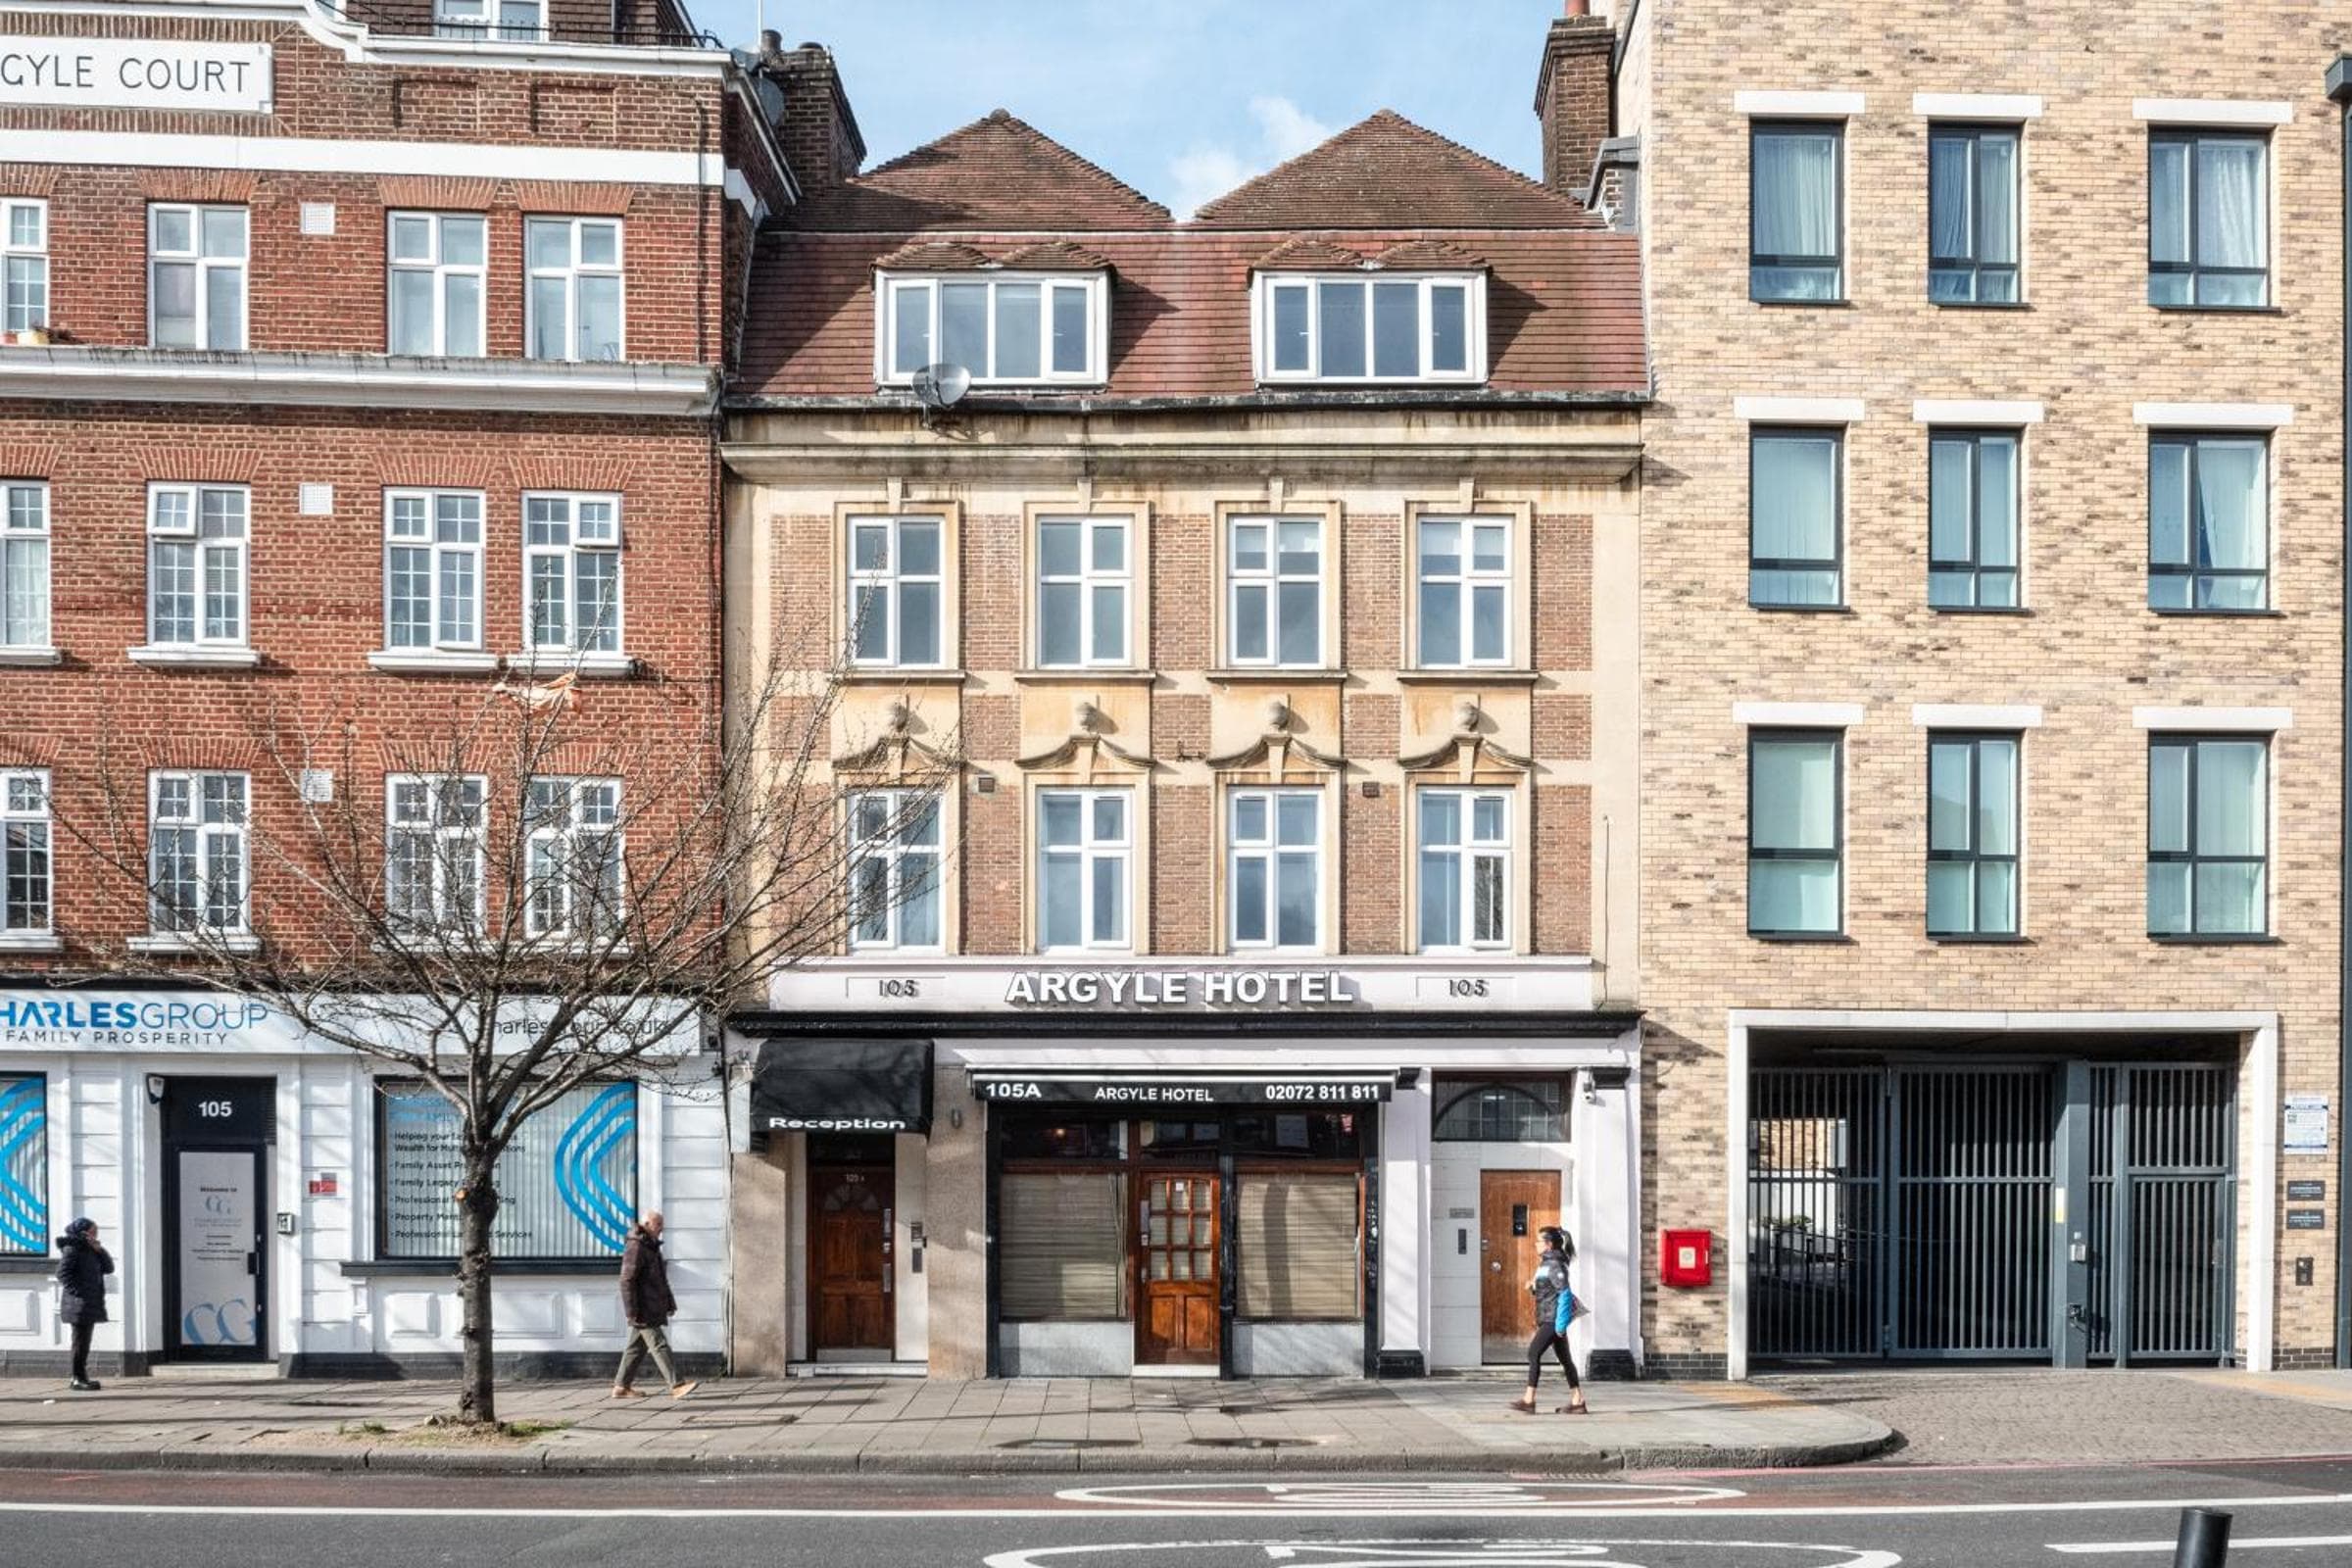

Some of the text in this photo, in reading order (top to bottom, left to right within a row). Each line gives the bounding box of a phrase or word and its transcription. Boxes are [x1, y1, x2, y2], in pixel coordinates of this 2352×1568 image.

[119, 57, 251, 93] COURT
[879, 979, 915, 997] 105
[1004, 971, 1353, 1004] ARGYLE HOTEL
[1449, 979, 1485, 997] 105
[6, 1030, 228, 1046] FAMILY PROSPERITY
[985, 1082, 1043, 1100] 105A
[1094, 1086, 1215, 1102] ARGYLE HOTEL
[1265, 1084, 1380, 1100] 02072 811 811
[198, 1100, 233, 1118] 105
[768, 1116, 906, 1132] Reception
